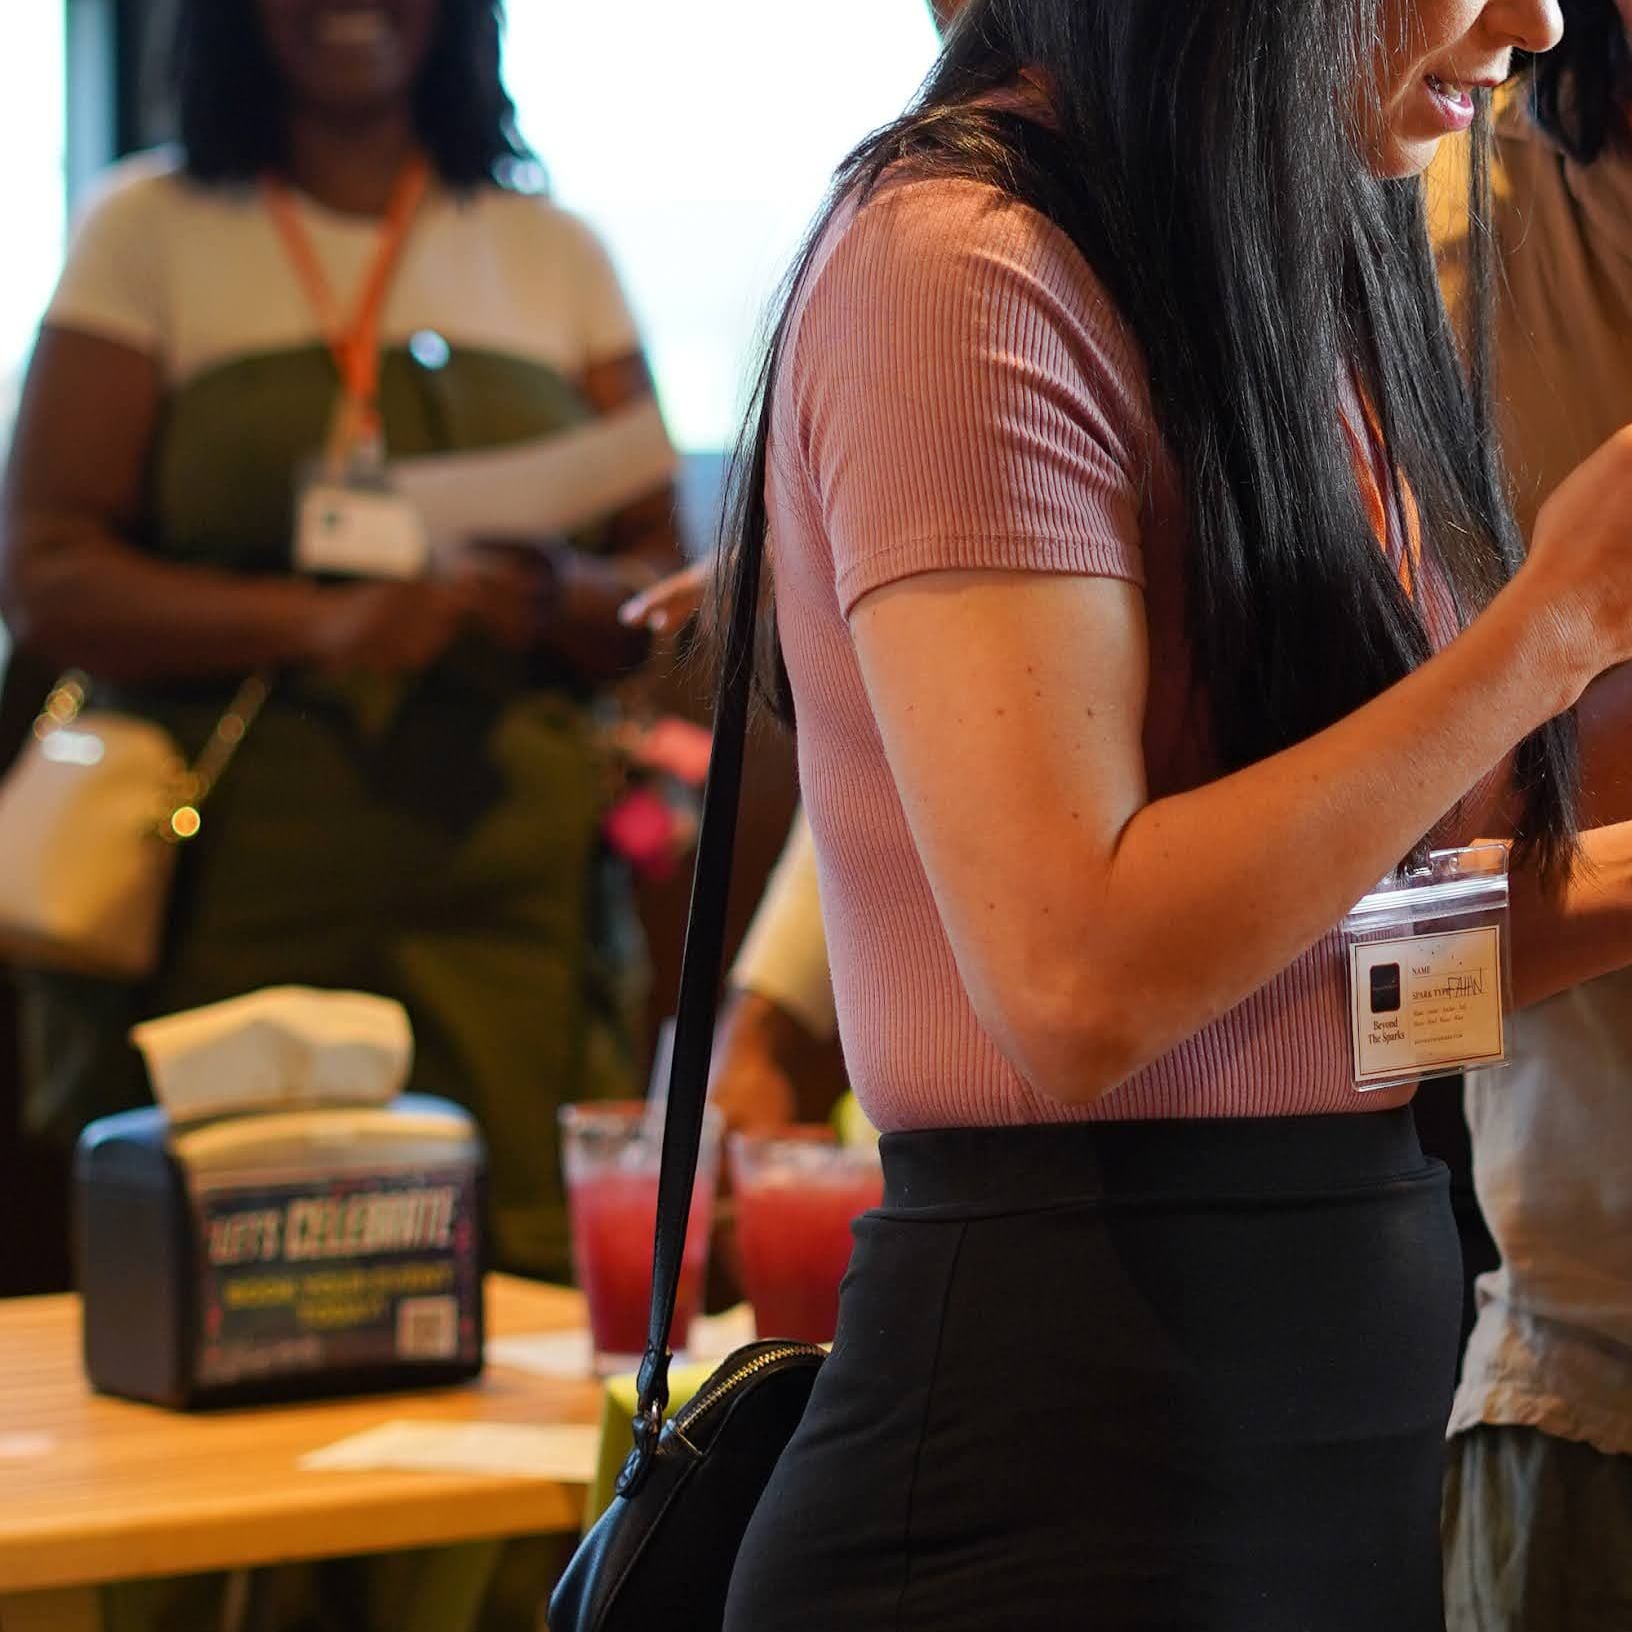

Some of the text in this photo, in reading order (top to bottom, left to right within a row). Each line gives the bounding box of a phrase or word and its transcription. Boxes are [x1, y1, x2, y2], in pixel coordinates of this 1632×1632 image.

[1412, 966, 1431, 975] NAME
[1373, 1015, 1398, 1031] Beyond
[1368, 1033, 1381, 1045] The
[1382, 1029, 1405, 1045] Sparks
